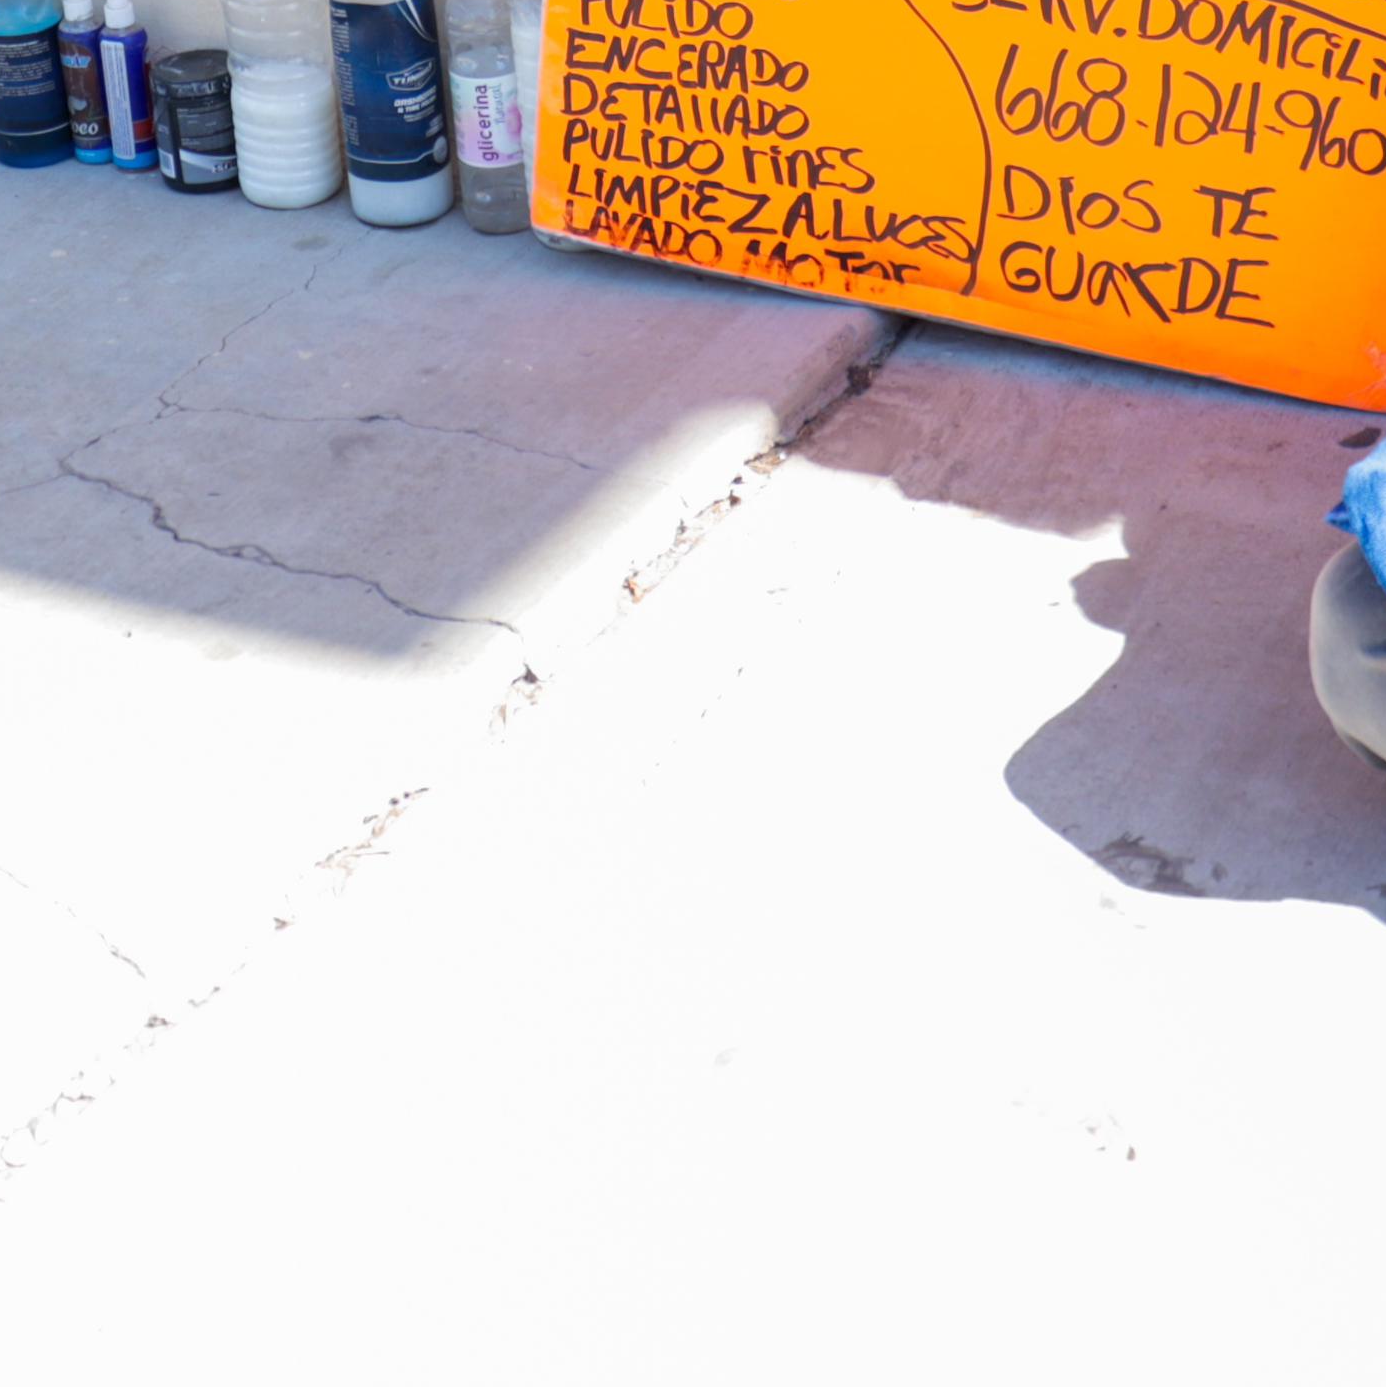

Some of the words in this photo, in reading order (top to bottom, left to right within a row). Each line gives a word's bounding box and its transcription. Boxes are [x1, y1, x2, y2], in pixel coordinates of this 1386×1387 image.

[565, 28, 810, 93] ENCERADO
[474, 85, 500, 162] glicerina
[562, 200, 723, 267] LAVADO
[1193, 185, 1280, 241] TE
